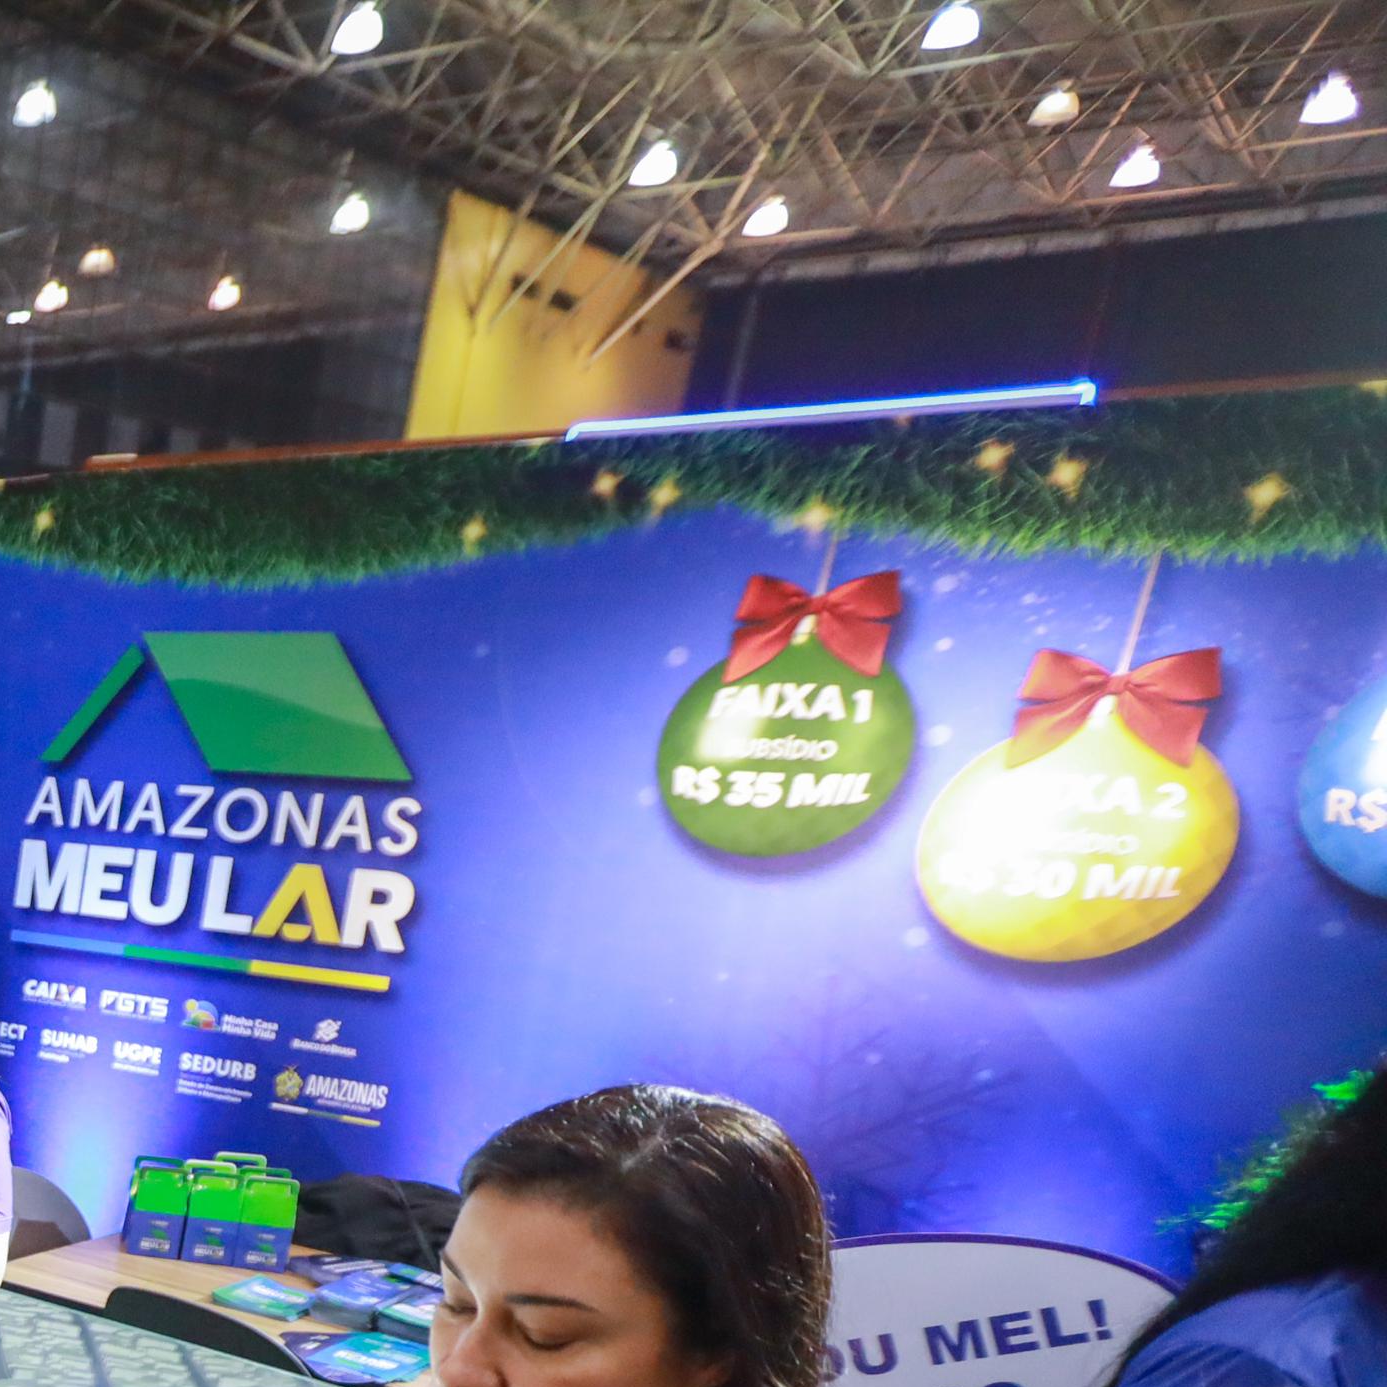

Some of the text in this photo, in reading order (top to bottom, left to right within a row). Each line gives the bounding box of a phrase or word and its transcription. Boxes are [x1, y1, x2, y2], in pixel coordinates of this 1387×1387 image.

[707, 681, 874, 724] FAIXA 1
[671, 765, 872, 810] R$ 35 MIL
[1151, 781, 1189, 820] 2
[25, 775, 423, 857] AMAZONAS
[13, 838, 416, 953] MEU LAR
[1082, 862, 1183, 902] MIL
[23, 979, 87, 1004] CAIXA
[40, 1028, 99, 1055] SUHAB
[221, 1014, 279, 1032] Minha Casa
[221, 1025, 277, 1041] Minha Vida
[113, 1040, 163, 1066] UGPE
[178, 1051, 257, 1083] SEDURB
[304, 1074, 389, 1110] AMAZONAS
[924, 1299, 1114, 1366] MEL!
